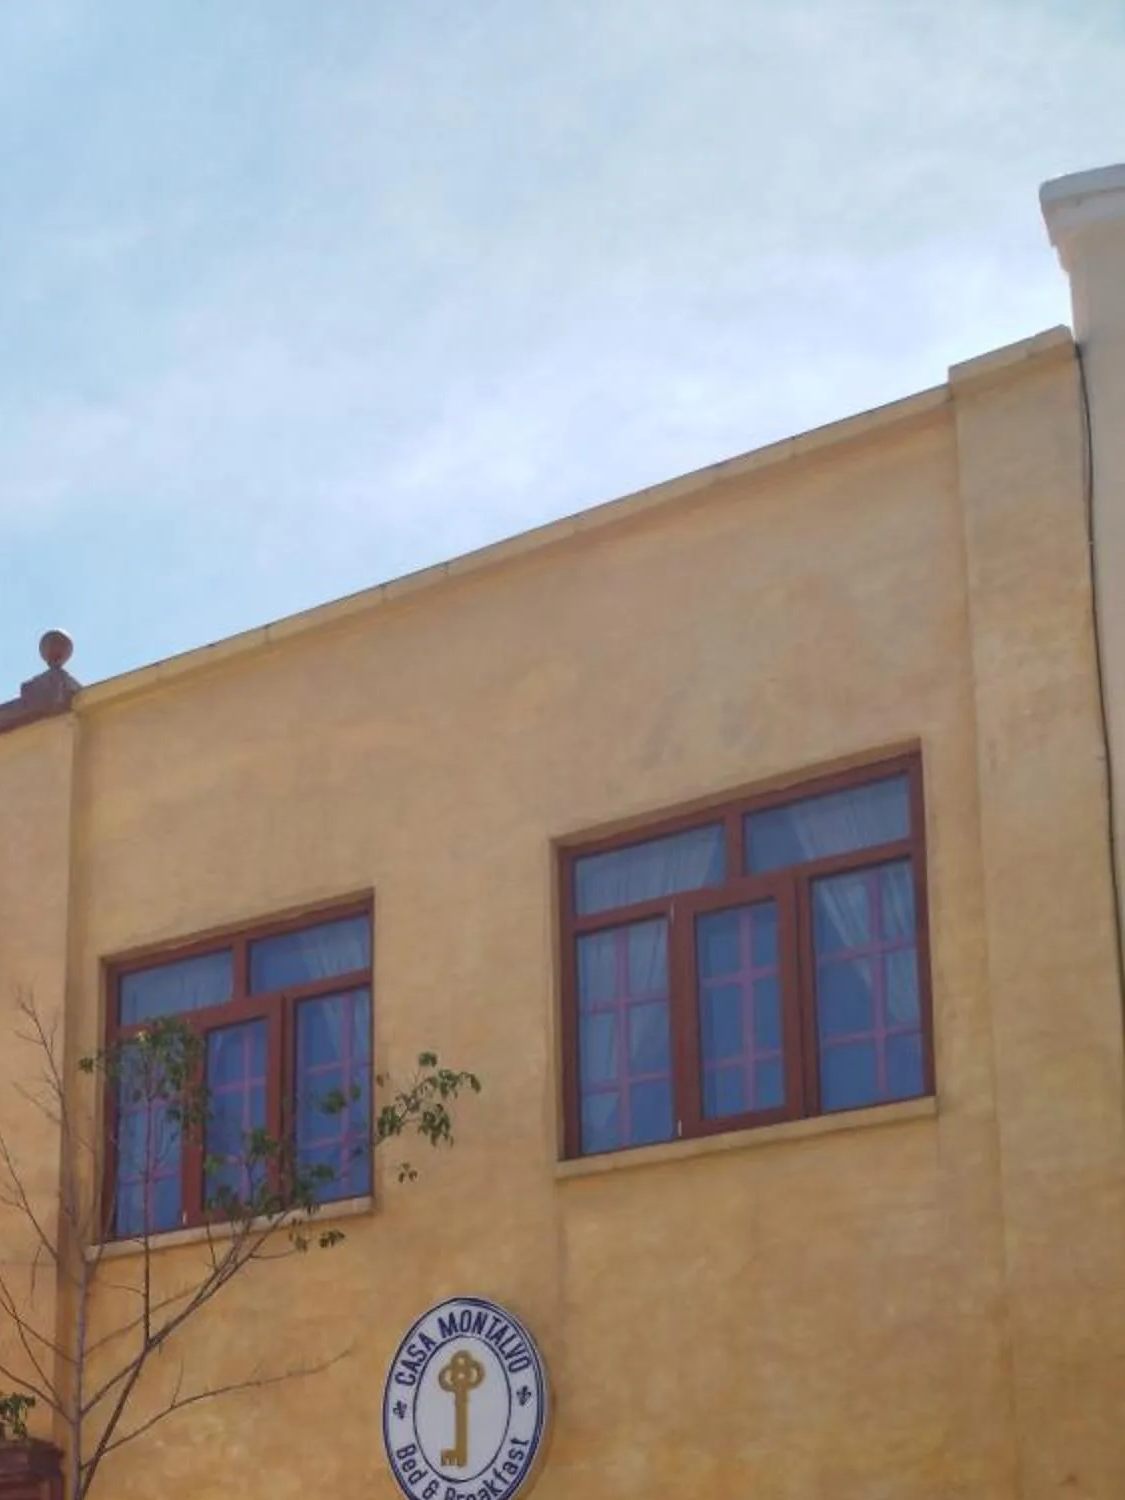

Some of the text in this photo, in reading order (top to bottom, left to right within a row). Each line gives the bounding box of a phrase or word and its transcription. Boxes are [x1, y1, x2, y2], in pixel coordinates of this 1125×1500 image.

[395, 1310, 532, 1386] CASA MONTALVO
[396, 1442, 426, 1486] Bed
